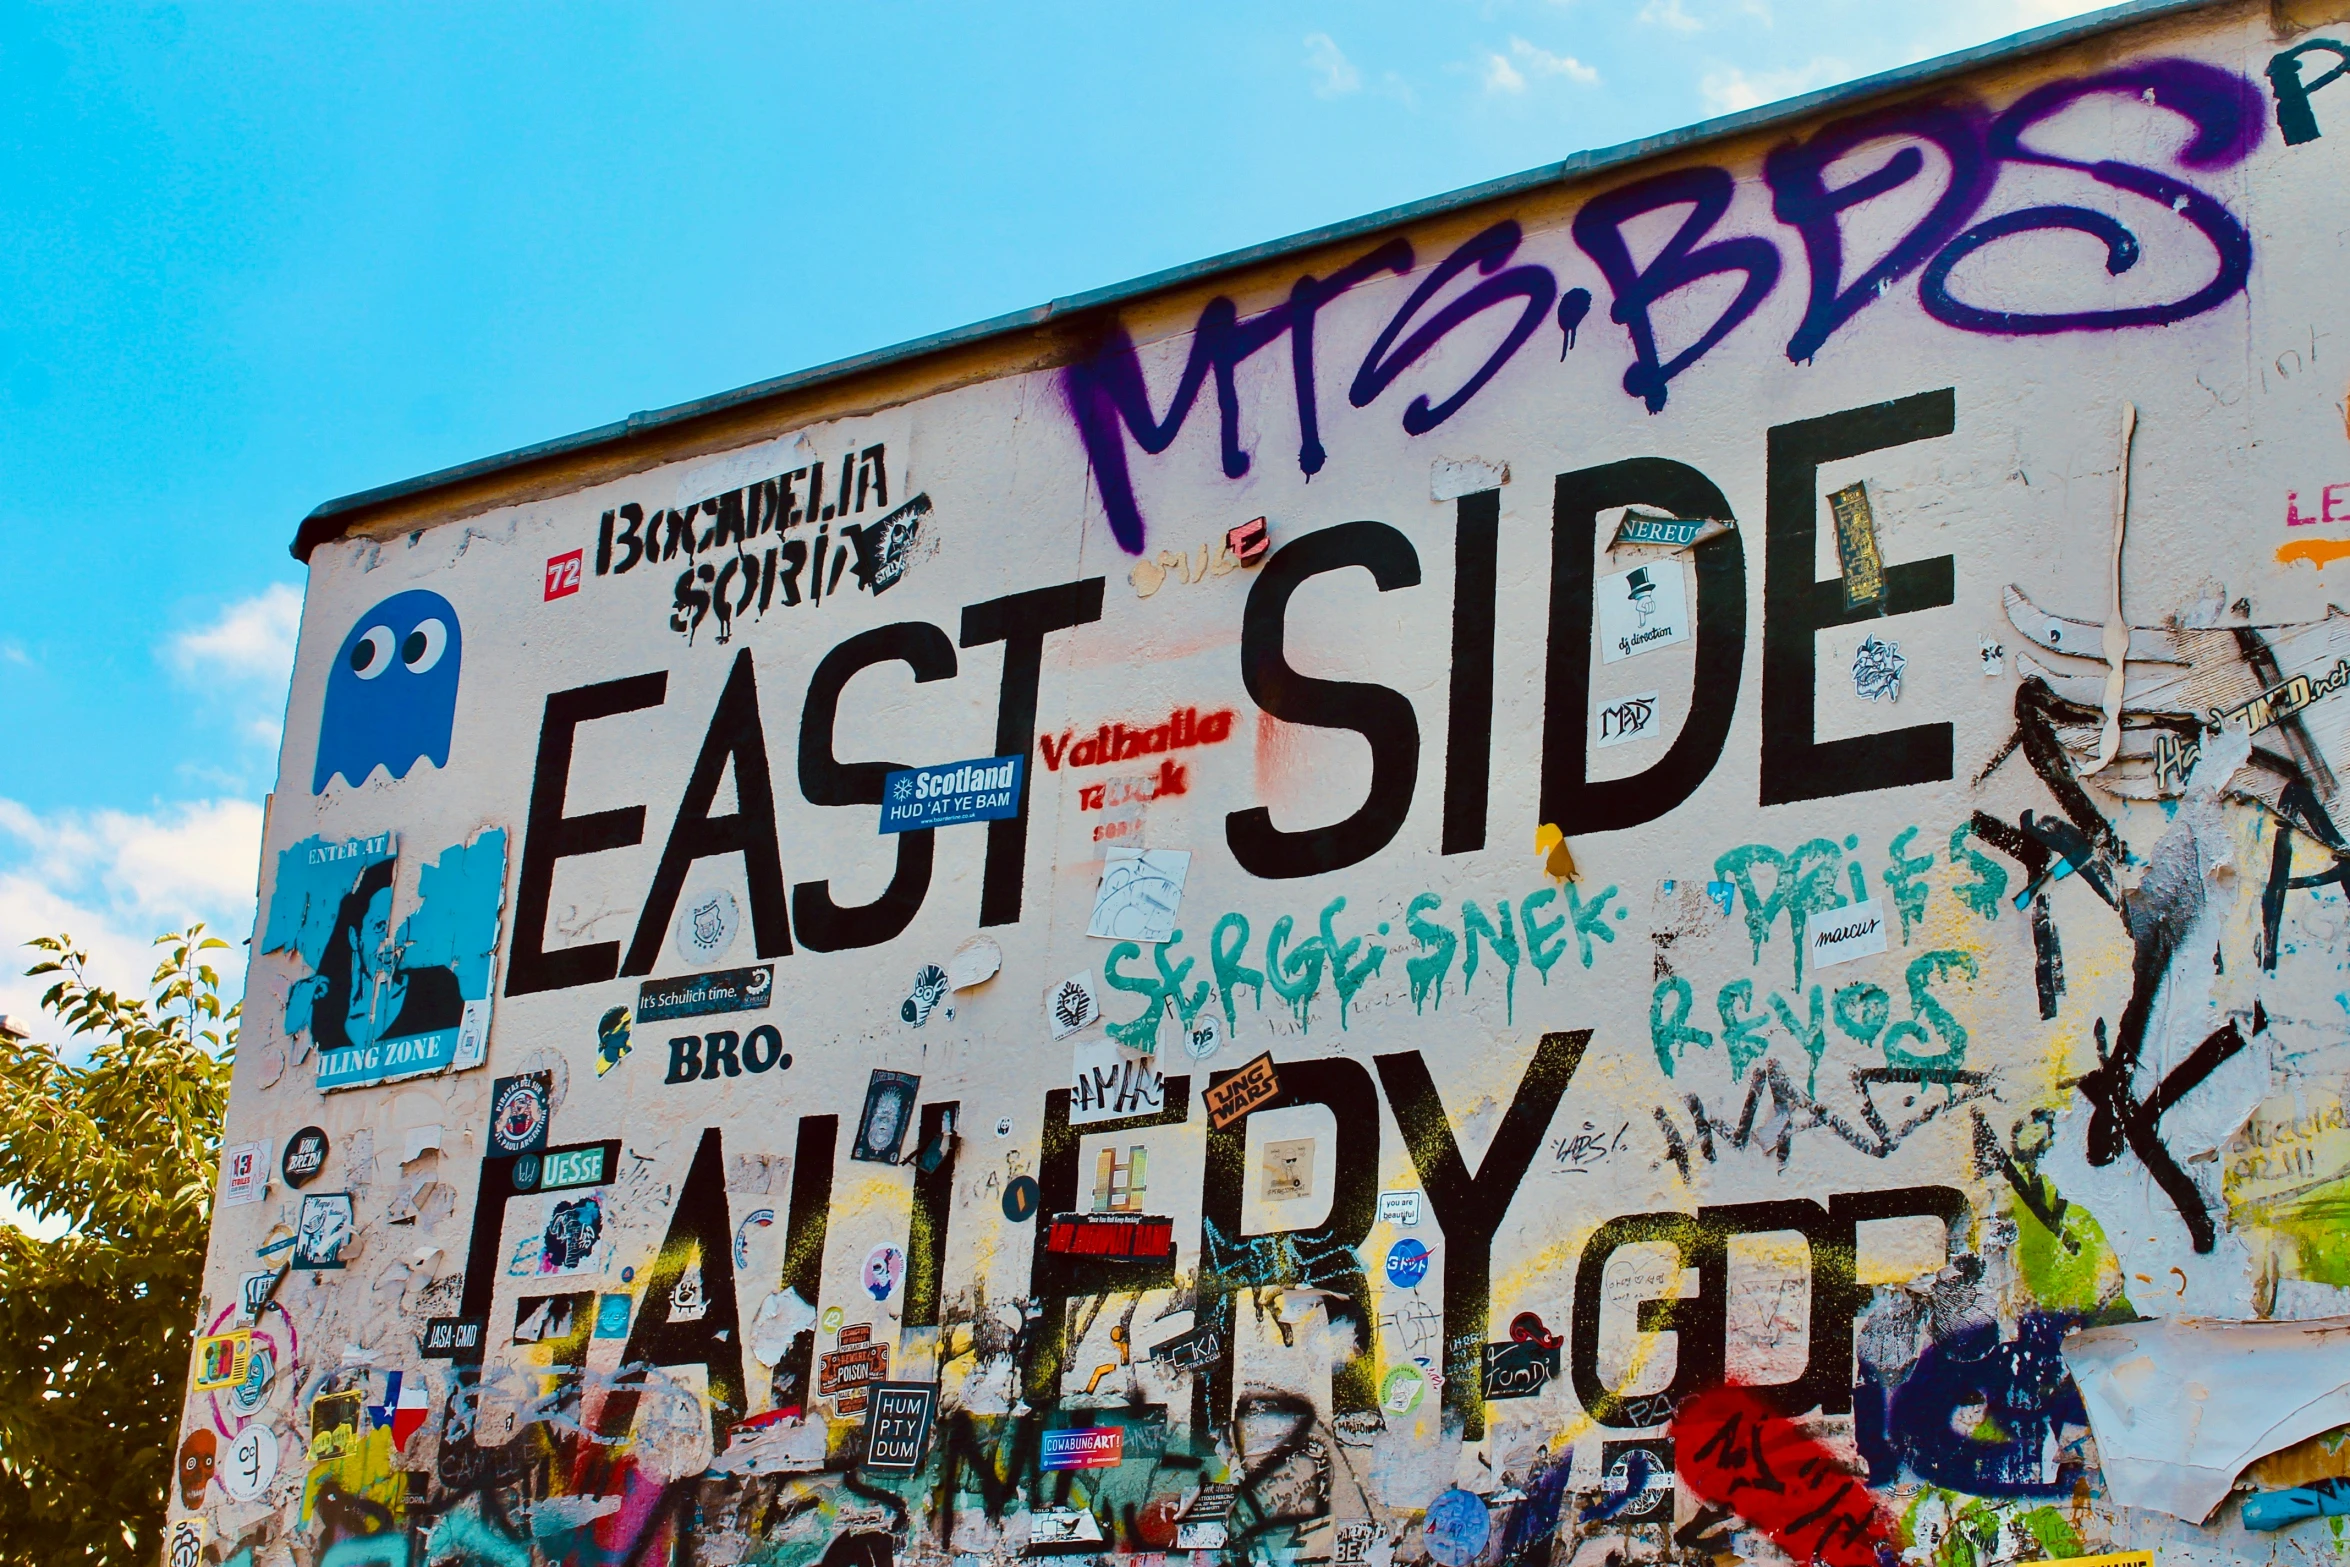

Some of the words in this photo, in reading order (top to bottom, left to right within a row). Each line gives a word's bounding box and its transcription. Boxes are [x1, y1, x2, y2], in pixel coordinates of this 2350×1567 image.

[548, 562, 581, 590] 72
[1618, 638, 1631, 654] dj
[1631, 625, 1673, 647] direction
[503, 576, 1105, 998] EAST
[1225, 386, 1956, 879] SIDE
[915, 761, 1015, 800] Scotland
[890, 803, 923, 820] HUD
[953, 796, 972, 812] YE
[975, 791, 1011, 809] BAM
[308, 840, 358, 865] ENTER
[362, 837, 385, 855] AT
[1814, 917, 1881, 948] marcus
[657, 988, 706, 1007] Schulich
[708, 986, 738, 1001] time.
[315, 1047, 379, 1077] ILING
[384, 1035, 442, 1067] ZONE
[664, 1024, 793, 1085] BRO.
[496, 1081, 520, 1112] PIRATAS
[520, 1079, 533, 1088] DEL
[531, 1081, 543, 1095] SUR
[1211, 1077, 1274, 1121] WARS
[500, 1140, 519, 1151] PAULI
[520, 1109, 548, 1150] ARGENTINA
[299, 1136, 320, 1154] VAN
[233, 1154, 253, 1177] 13
[287, 1149, 322, 1171] BREDA
[1383, 1210, 1415, 1219] beautiful
[1386, 1199, 1400, 1208] you
[837, 1362, 870, 1384] POISON
[1388, 1367, 1400, 1379] FOOD
[883, 1398, 921, 1414] HUM
[879, 1419, 917, 1436] PTY
[876, 1440, 915, 1457] DUM
